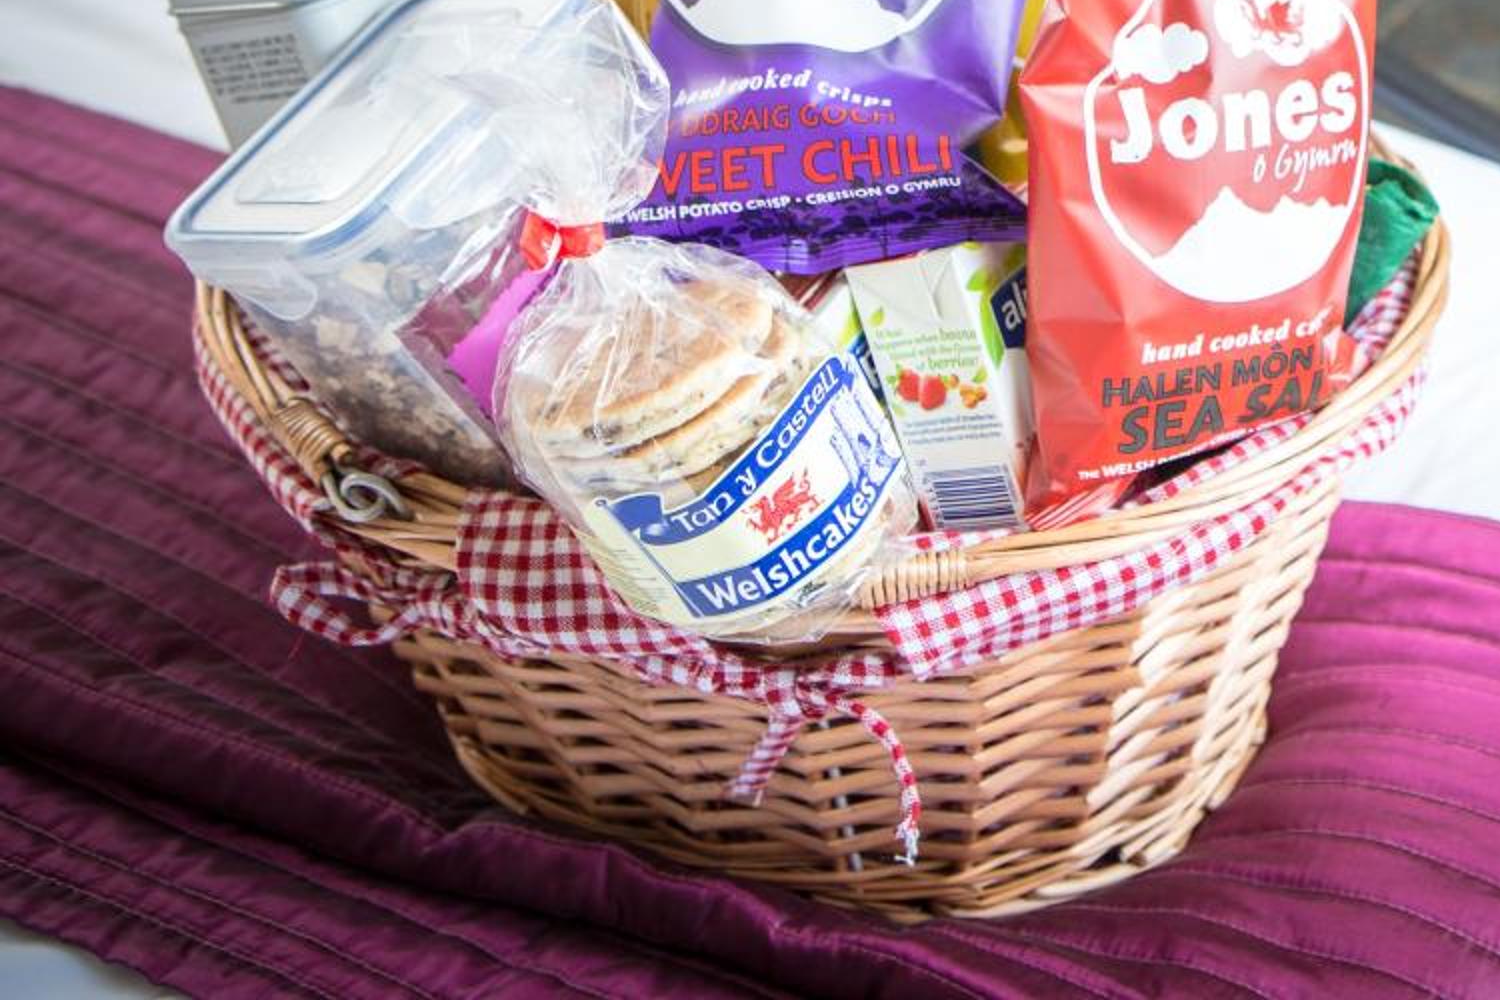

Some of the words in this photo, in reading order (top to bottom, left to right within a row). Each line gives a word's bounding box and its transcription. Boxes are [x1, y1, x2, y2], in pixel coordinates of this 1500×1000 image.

[673, 78, 726, 108] hand
[729, 68, 813, 96] cooked
[1109, 70, 1358, 164] Jones
[657, 143, 786, 197] EET
[801, 131, 955, 186] CHILI
[627, 204, 677, 223] WELSH
[679, 199, 743, 219] POTATO
[745, 195, 792, 213] CRISP
[885, 184, 900, 195] O
[902, 176, 962, 193] GYMRU
[1141, 333, 1204, 364] hand
[1209, 318, 1291, 352] cooked
[1101, 362, 1222, 408] HALEN
[1231, 343, 1314, 387] MÔN
[1118, 395, 1226, 454] SEA
[1236, 369, 1324, 423] SAL
[671, 490, 736, 534] Tan
[735, 466, 758, 496] y
[755, 363, 840, 470] Castell
[1078, 468, 1100, 480] THE
[697, 476, 878, 611] Welshcakes
